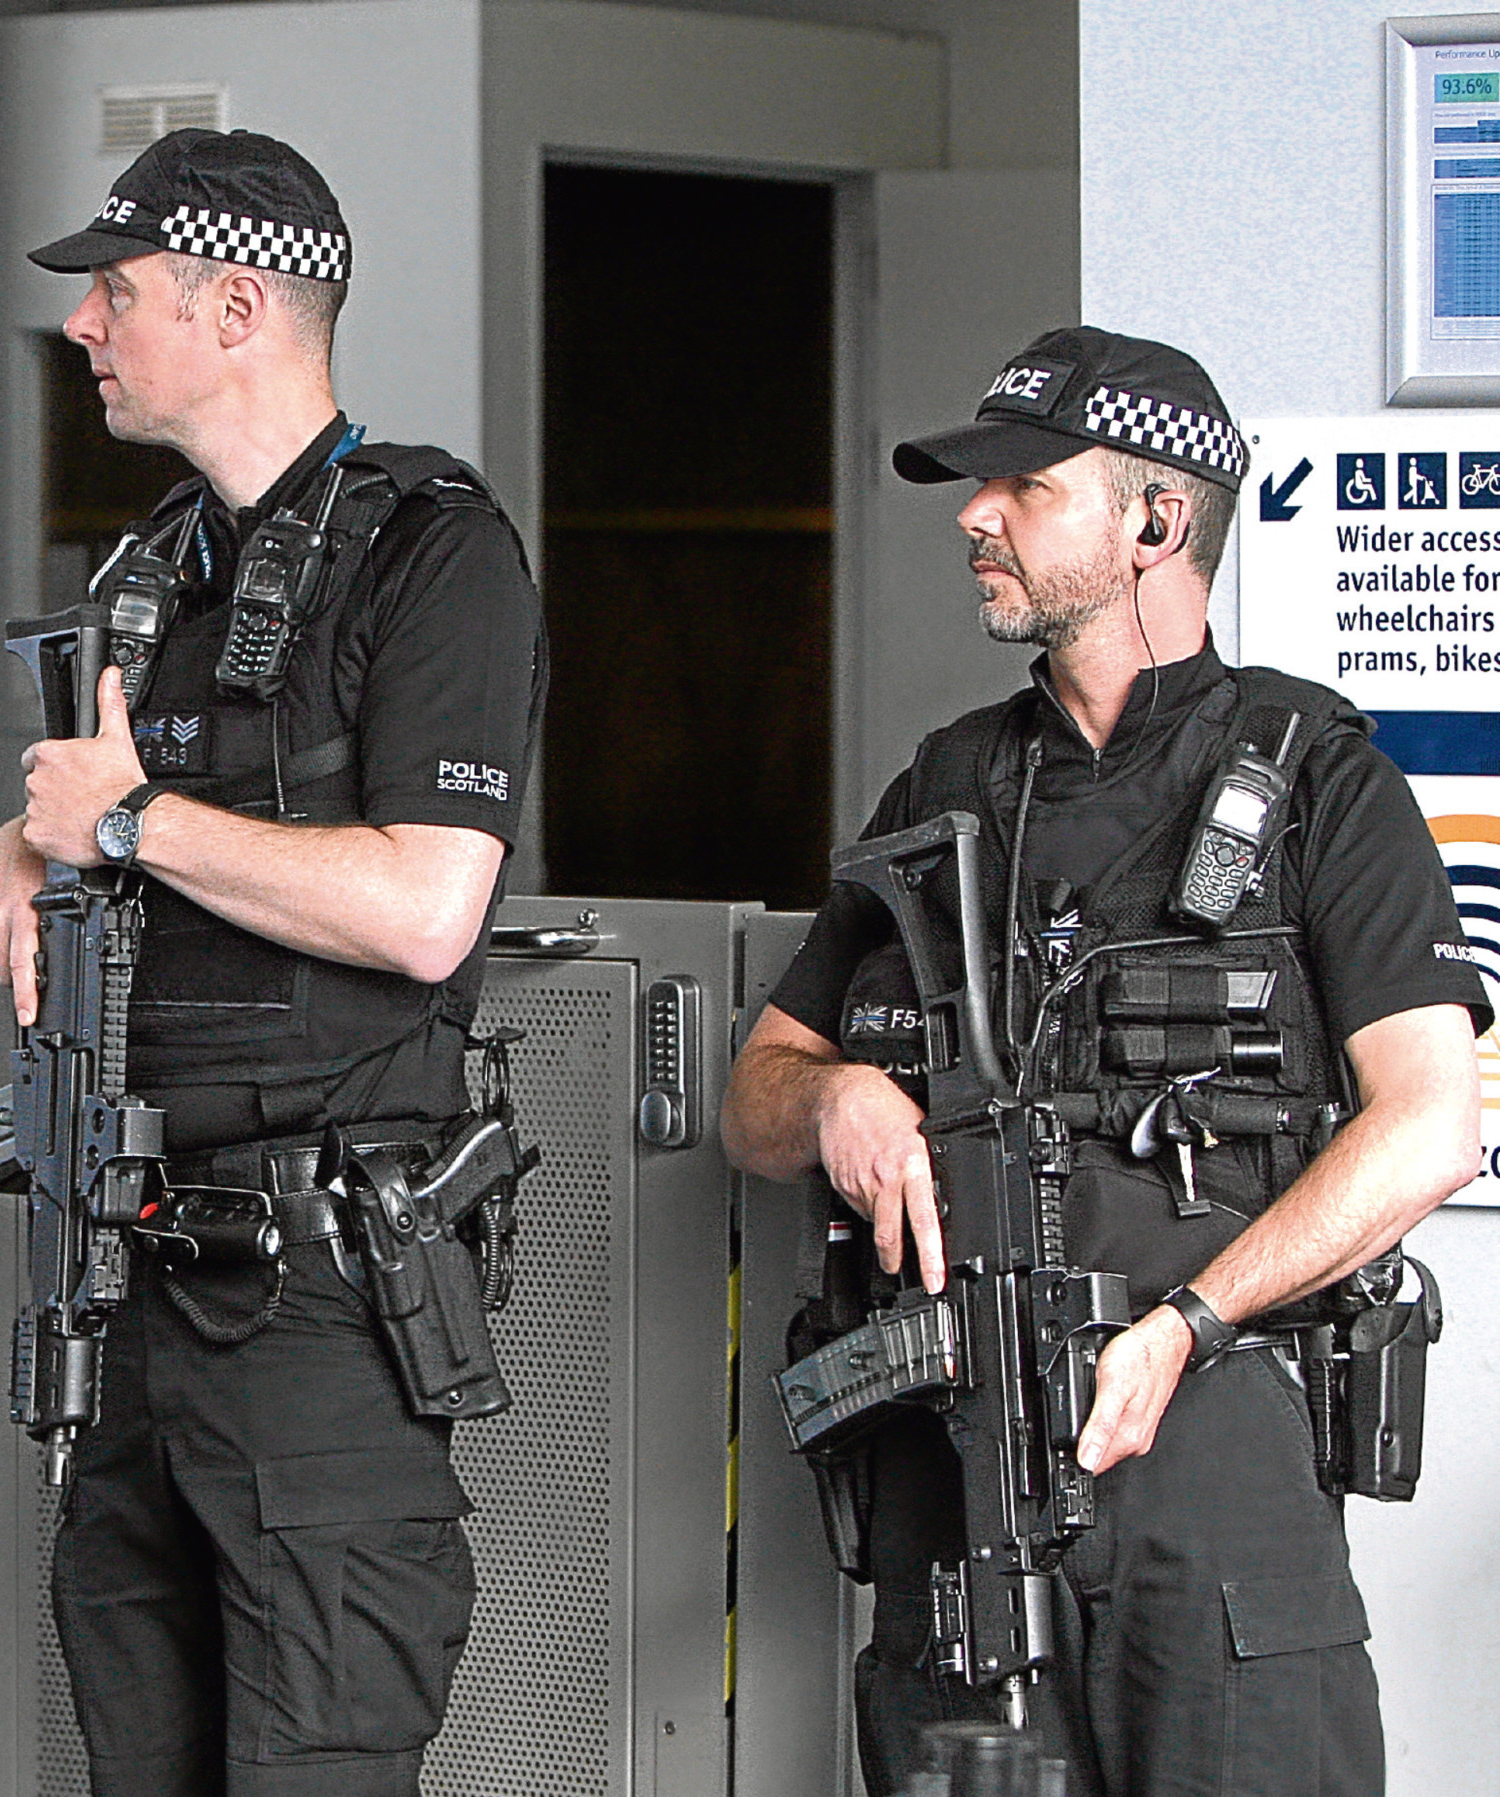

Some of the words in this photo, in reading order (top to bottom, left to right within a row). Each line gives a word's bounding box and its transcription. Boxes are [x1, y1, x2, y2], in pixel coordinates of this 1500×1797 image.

[1442, 77, 1492, 95] 93.6%
[1336, 524, 1414, 553] Wider
[1336, 563, 1456, 593] available
[1462, 563, 1500, 593] for
[1336, 603, 1495, 633] wheelchairs
[1338, 651, 1427, 679] prams,
[161, 747, 188, 765] 543
[439, 760, 509, 788] POLICE
[437, 778, 508, 801] SCOTLAND
